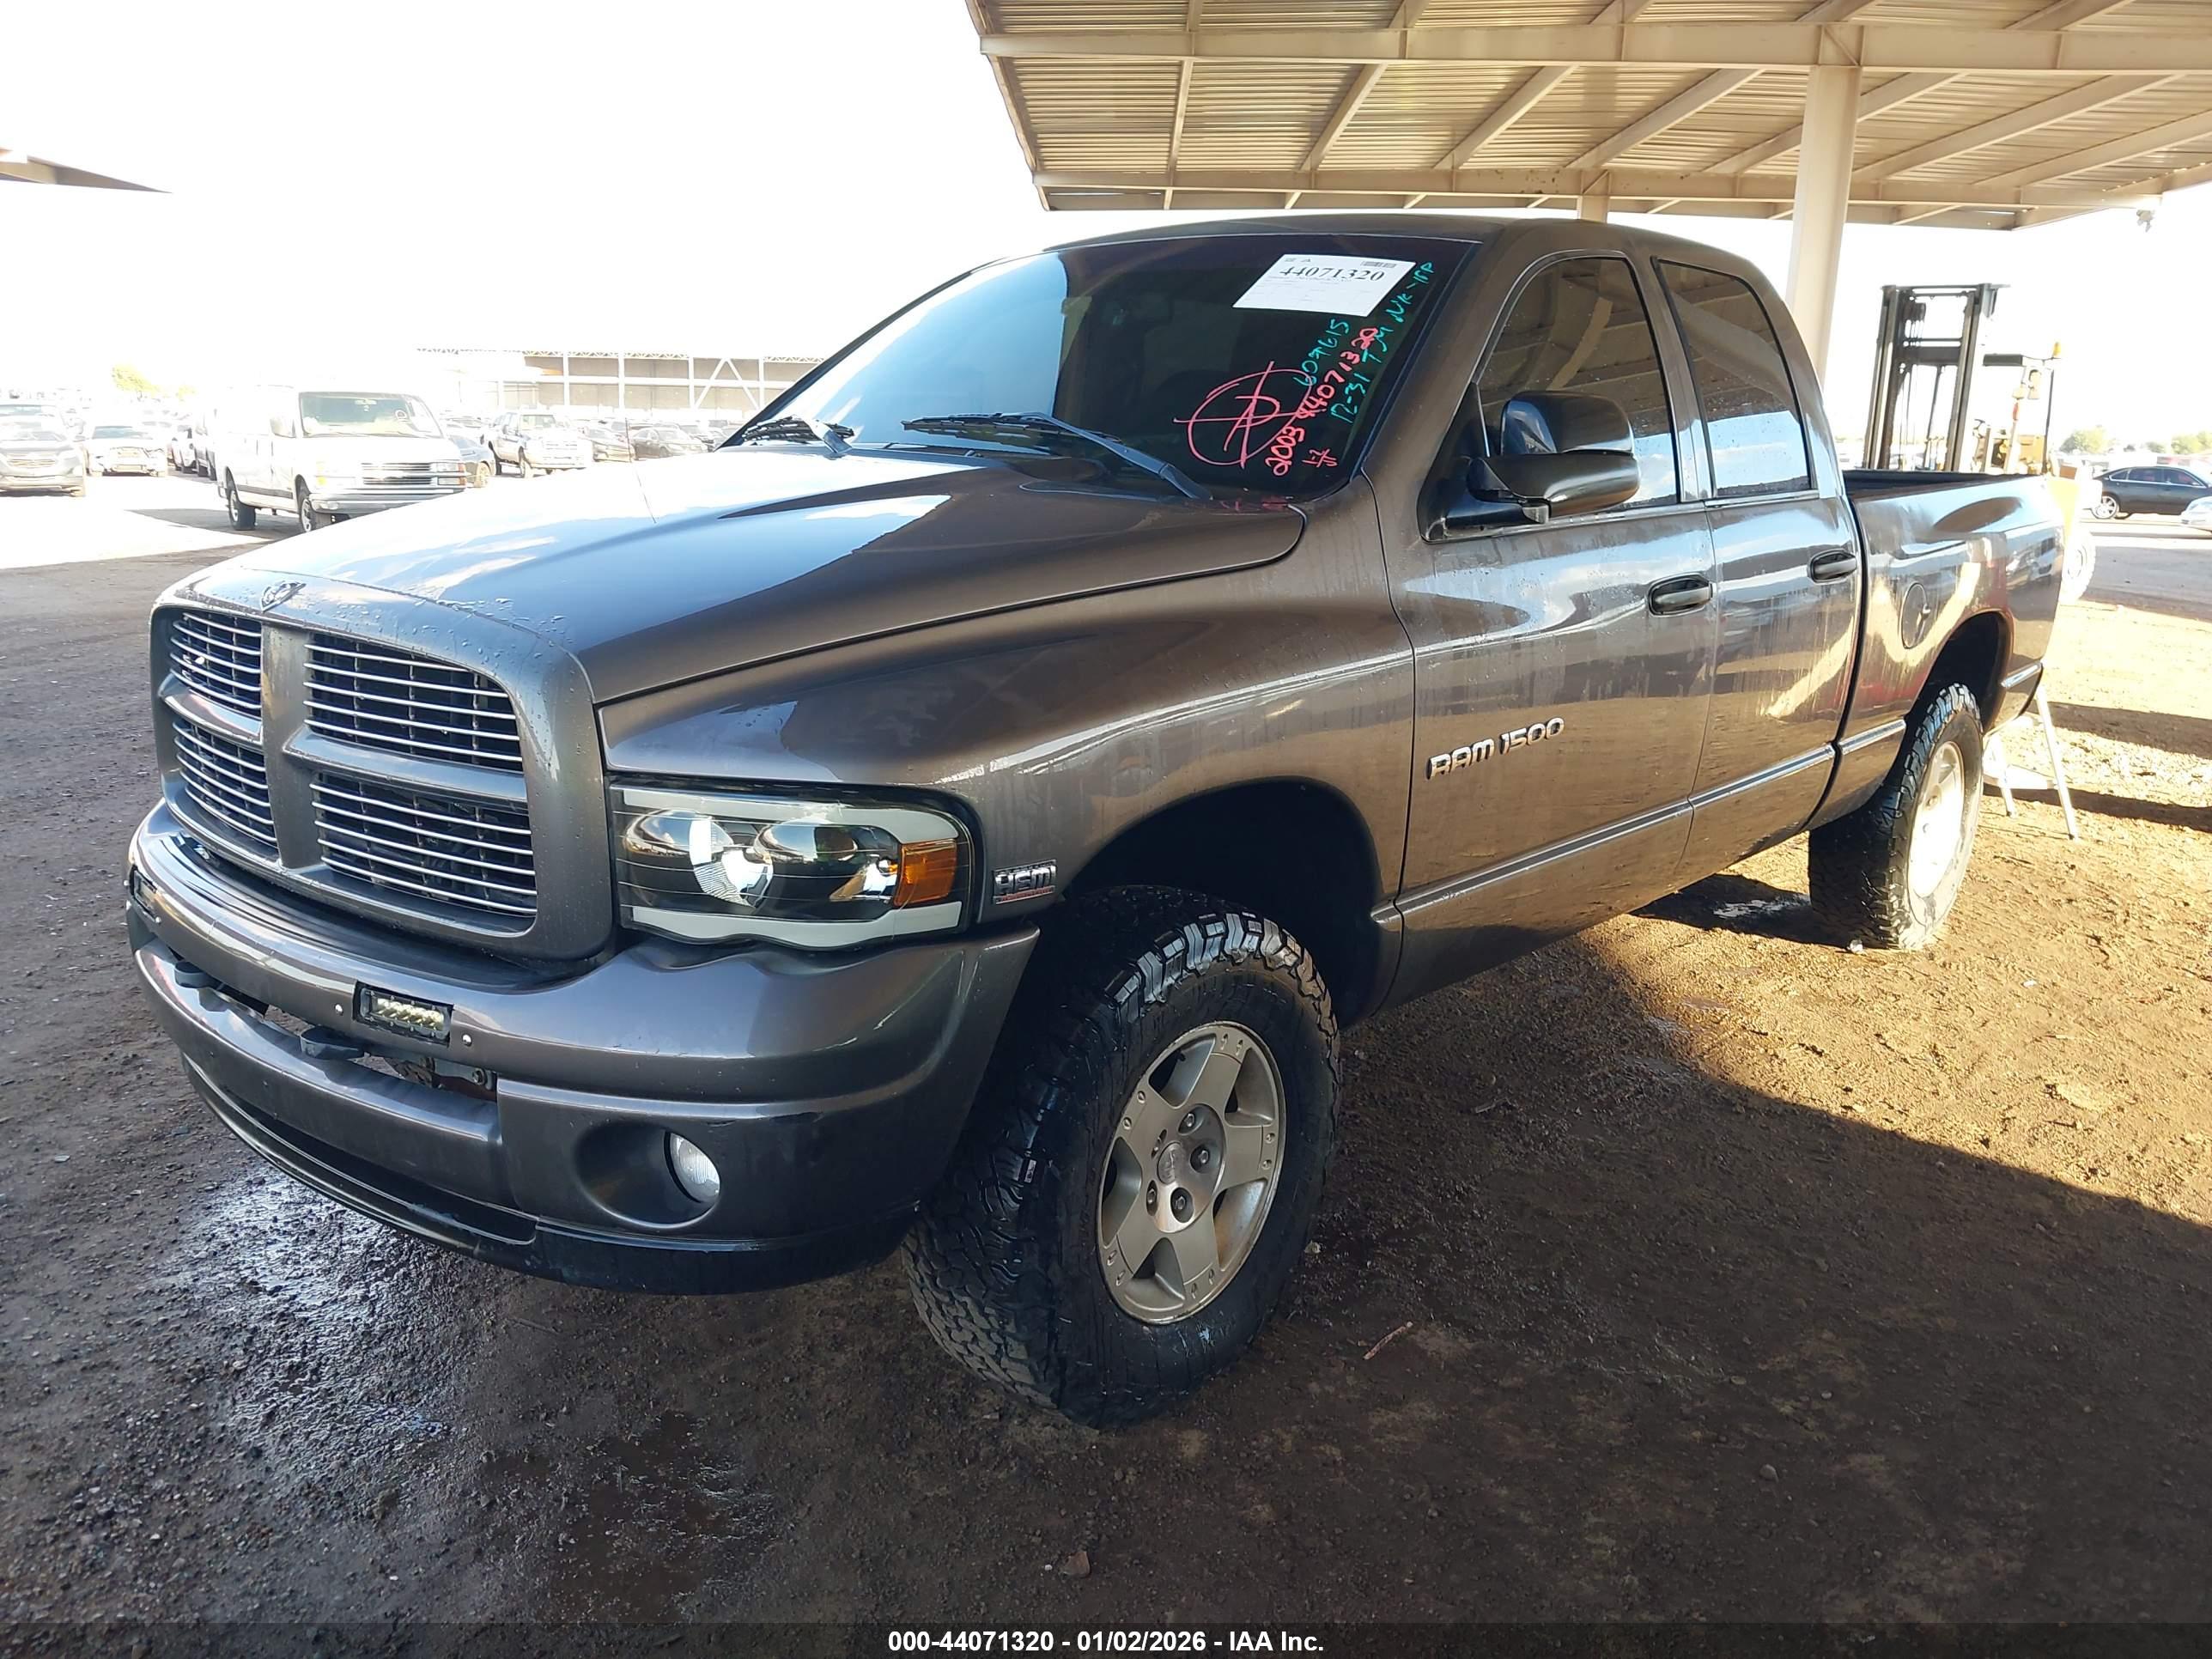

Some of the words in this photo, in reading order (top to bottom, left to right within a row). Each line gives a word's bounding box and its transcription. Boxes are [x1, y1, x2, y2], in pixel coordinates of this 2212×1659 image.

[1279, 265, 1384, 282] 44071320
[1265, 426, 1305, 477] 2003
[1426, 738, 1495, 780] RAM
[1499, 717, 1565, 755] 1500
